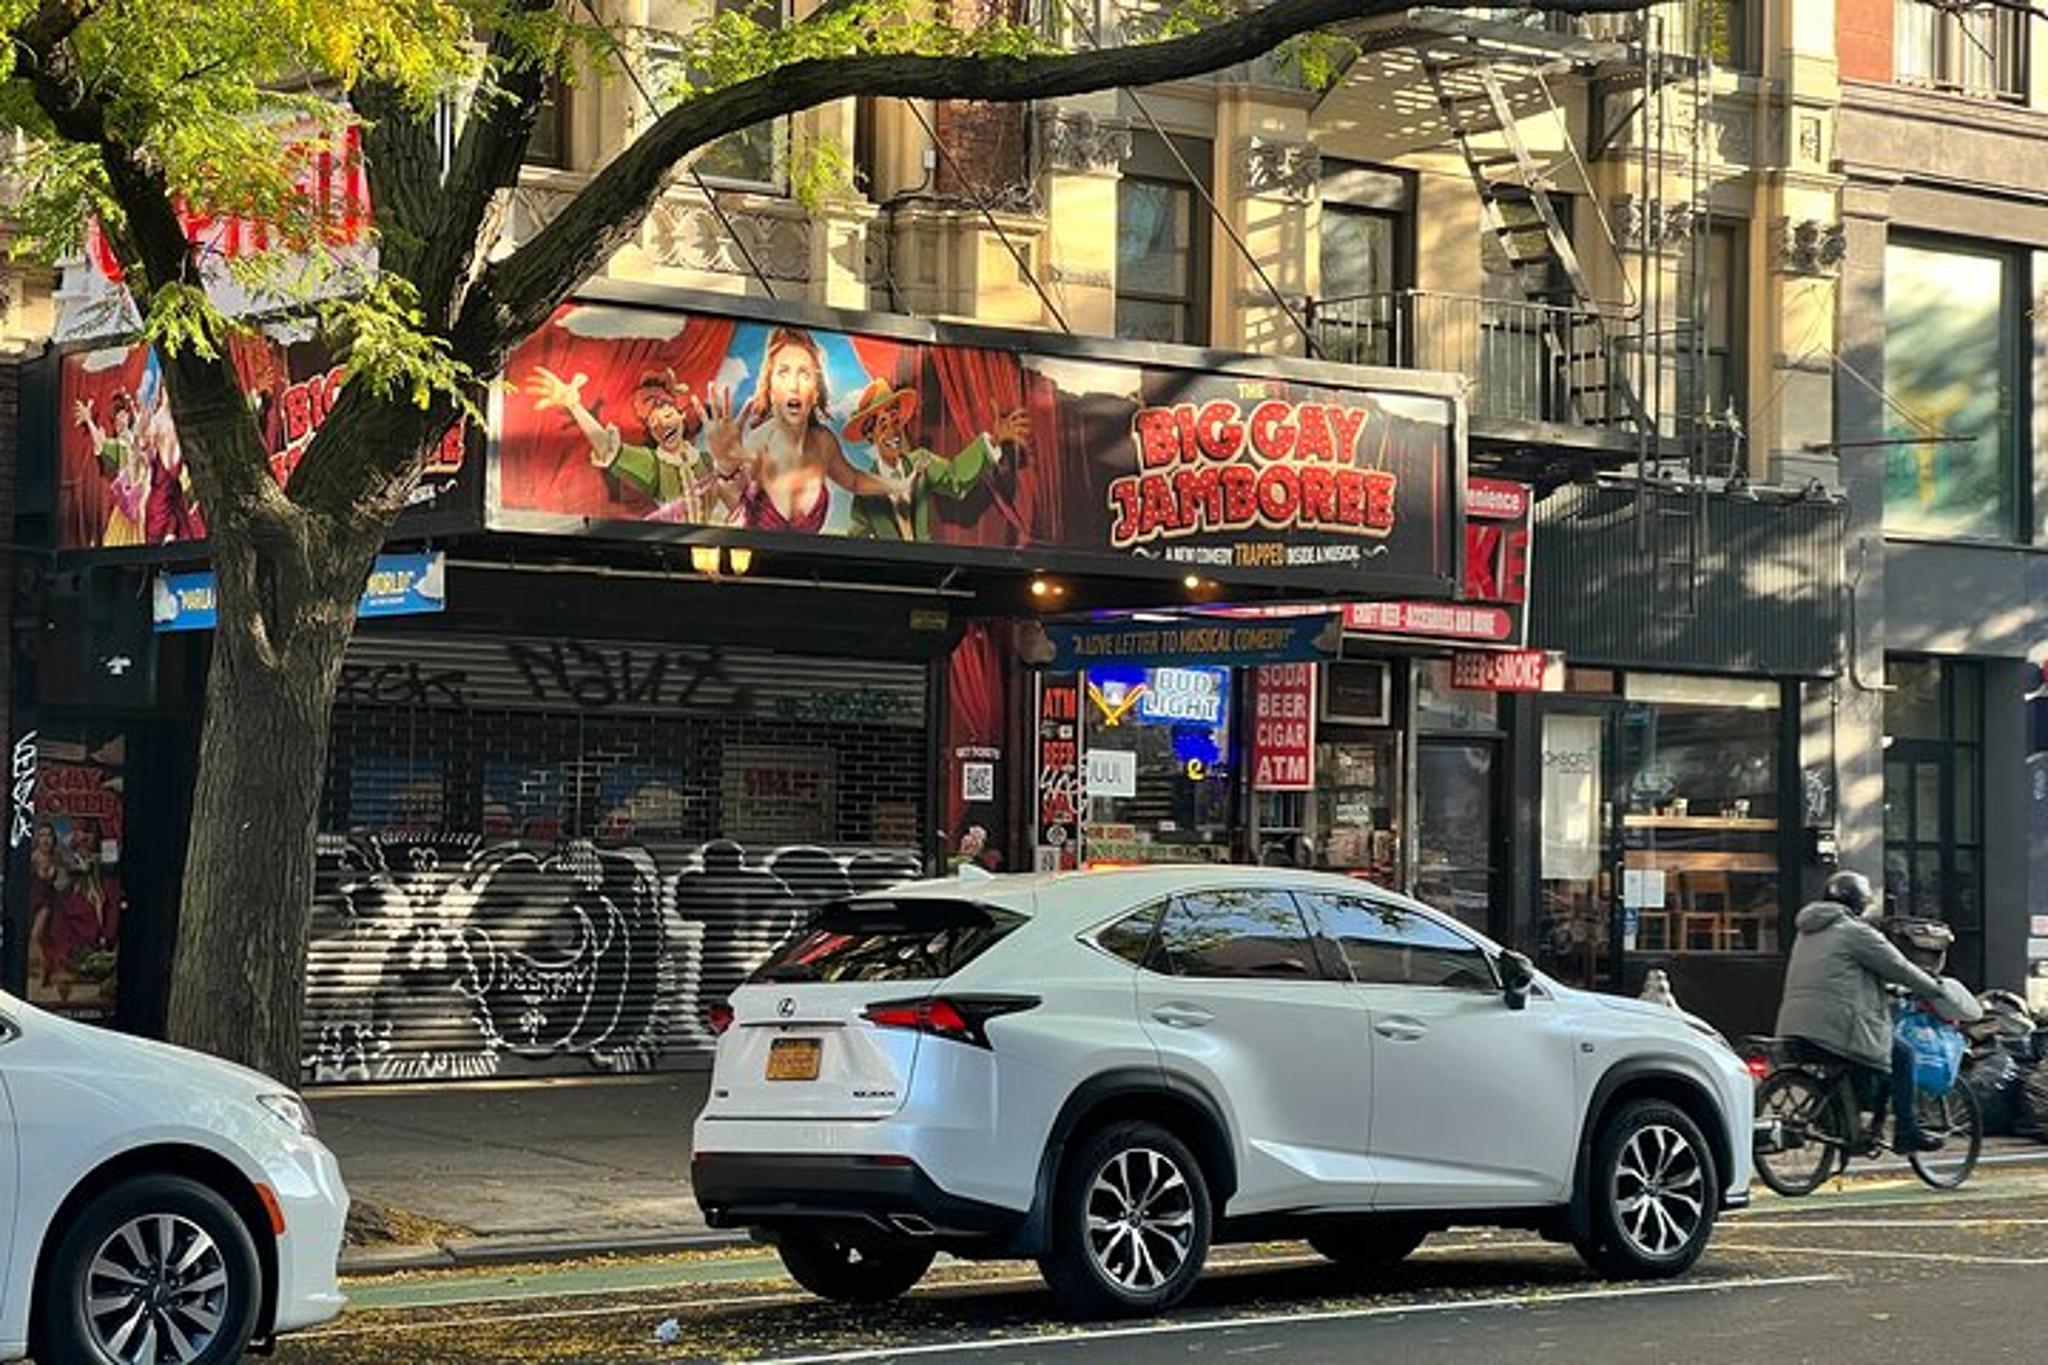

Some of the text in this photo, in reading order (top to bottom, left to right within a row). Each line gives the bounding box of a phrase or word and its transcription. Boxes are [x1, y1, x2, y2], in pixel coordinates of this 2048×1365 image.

[1237, 383, 1266, 399] THE
[1132, 399, 1368, 474] BIG GAY
[1109, 463, 1397, 547] JAMBOREE
[1234, 543, 1286, 567] TRAPPED
[1115, 631, 1159, 656] LETTER
[1162, 631, 1178, 653] TO
[1180, 629, 1231, 653] MUSICAL
[1156, 667, 1212, 694] BUD
[1257, 663, 1307, 686] SODA
[1043, 687, 1076, 718] ATM
[1143, 690, 1219, 722] LIGHT
[1256, 692, 1307, 719] BEER
[1256, 723, 1307, 749] CIGAR
[1257, 755, 1307, 782] ATM
